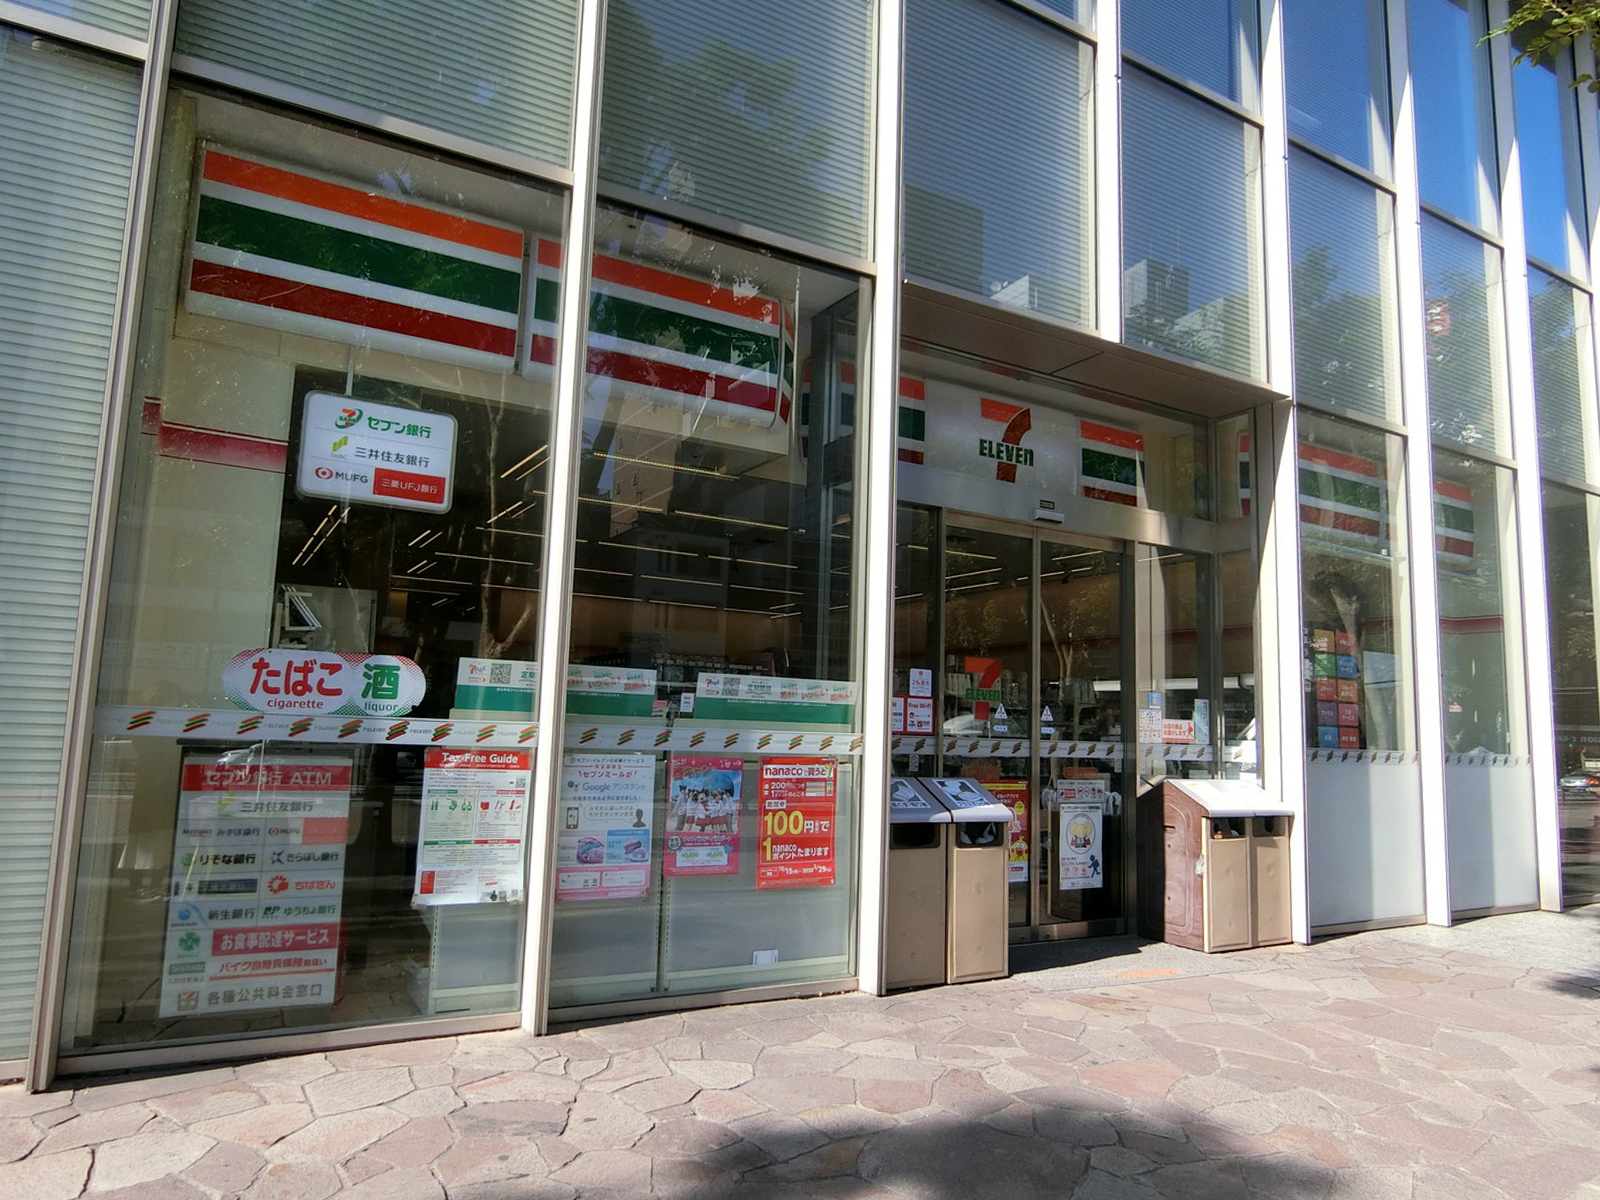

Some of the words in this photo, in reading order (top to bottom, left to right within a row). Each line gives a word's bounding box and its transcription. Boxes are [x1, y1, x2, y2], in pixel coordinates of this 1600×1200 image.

[367, 416, 432, 440] セブン銀行
[354, 446, 430, 468] 三井住友銀行
[335, 471, 368, 484] MUFG
[381, 478, 438, 495] 三菱UFJ銀行
[250, 656, 343, 697] たばこ
[361, 663, 400, 700] 酒
[267, 698, 323, 710] cigarette
[364, 701, 398, 713] liquor
[489, 753, 519, 764] Guide
[290, 772, 332, 785] ATM
[582, 770, 634, 778] セブンミールが
[582, 782, 611, 793] Google
[240, 801, 315, 813] 三井住友銀行
[216, 828, 260, 837] みずほ銀行
[772, 844, 797, 853] nanaco
[797, 847, 830, 857] たまります
[200, 853, 256, 865] りそな銀行
[287, 851, 339, 862] きらぼし銀行
[772, 852, 798, 860] ポイント
[294, 880, 336, 890] ちばぎん
[208, 907, 255, 921] 新生銀行
[284, 904, 337, 917] ゆうちょ銀行
[221, 928, 330, 951] お食事配達サービス
[208, 984, 322, 1005] 各種公共料金窓口
